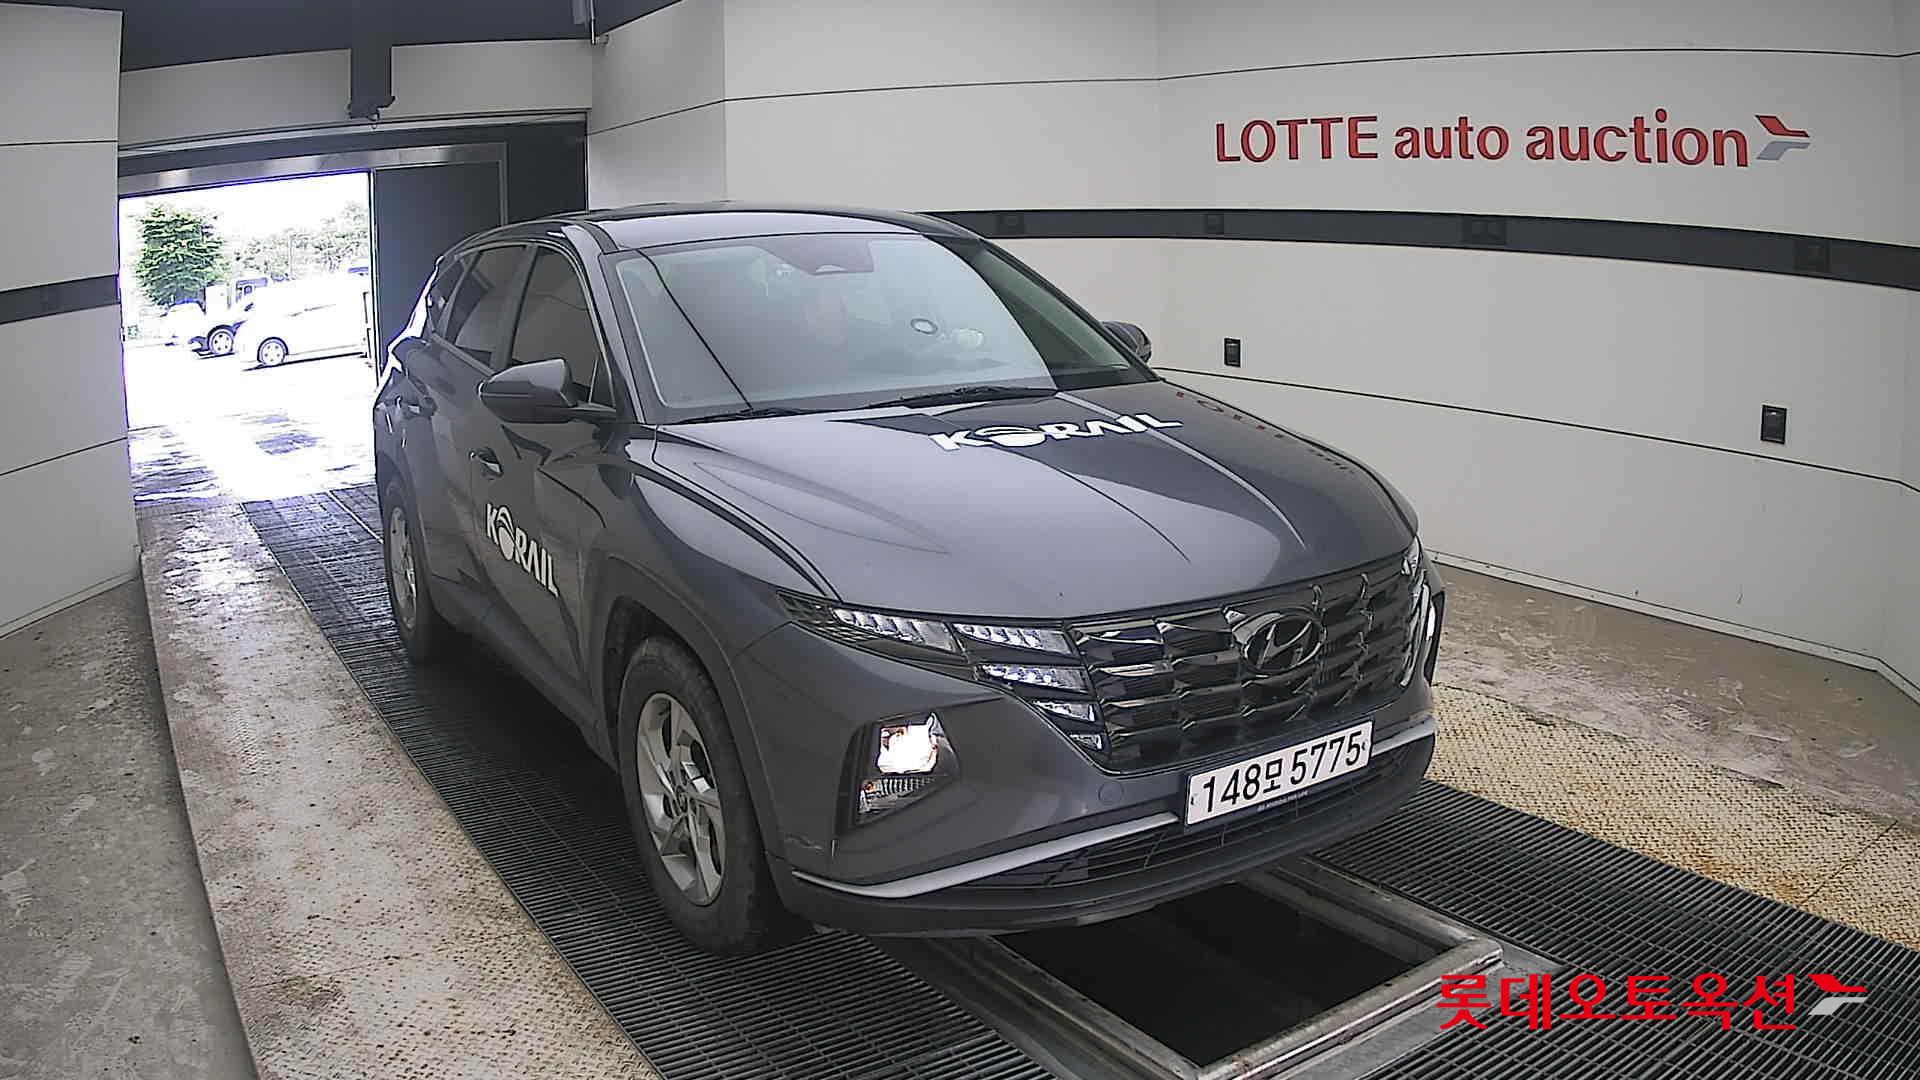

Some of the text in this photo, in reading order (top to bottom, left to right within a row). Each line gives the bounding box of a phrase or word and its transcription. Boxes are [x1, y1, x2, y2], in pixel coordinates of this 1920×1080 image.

[1215, 108, 1749, 168] LOTTE auto auction
[928, 413, 1185, 451] KORAIL
[485, 503, 559, 598] KORAIL
[1203, 758, 1284, 813] 148모
[1290, 730, 1363, 786] 5775
